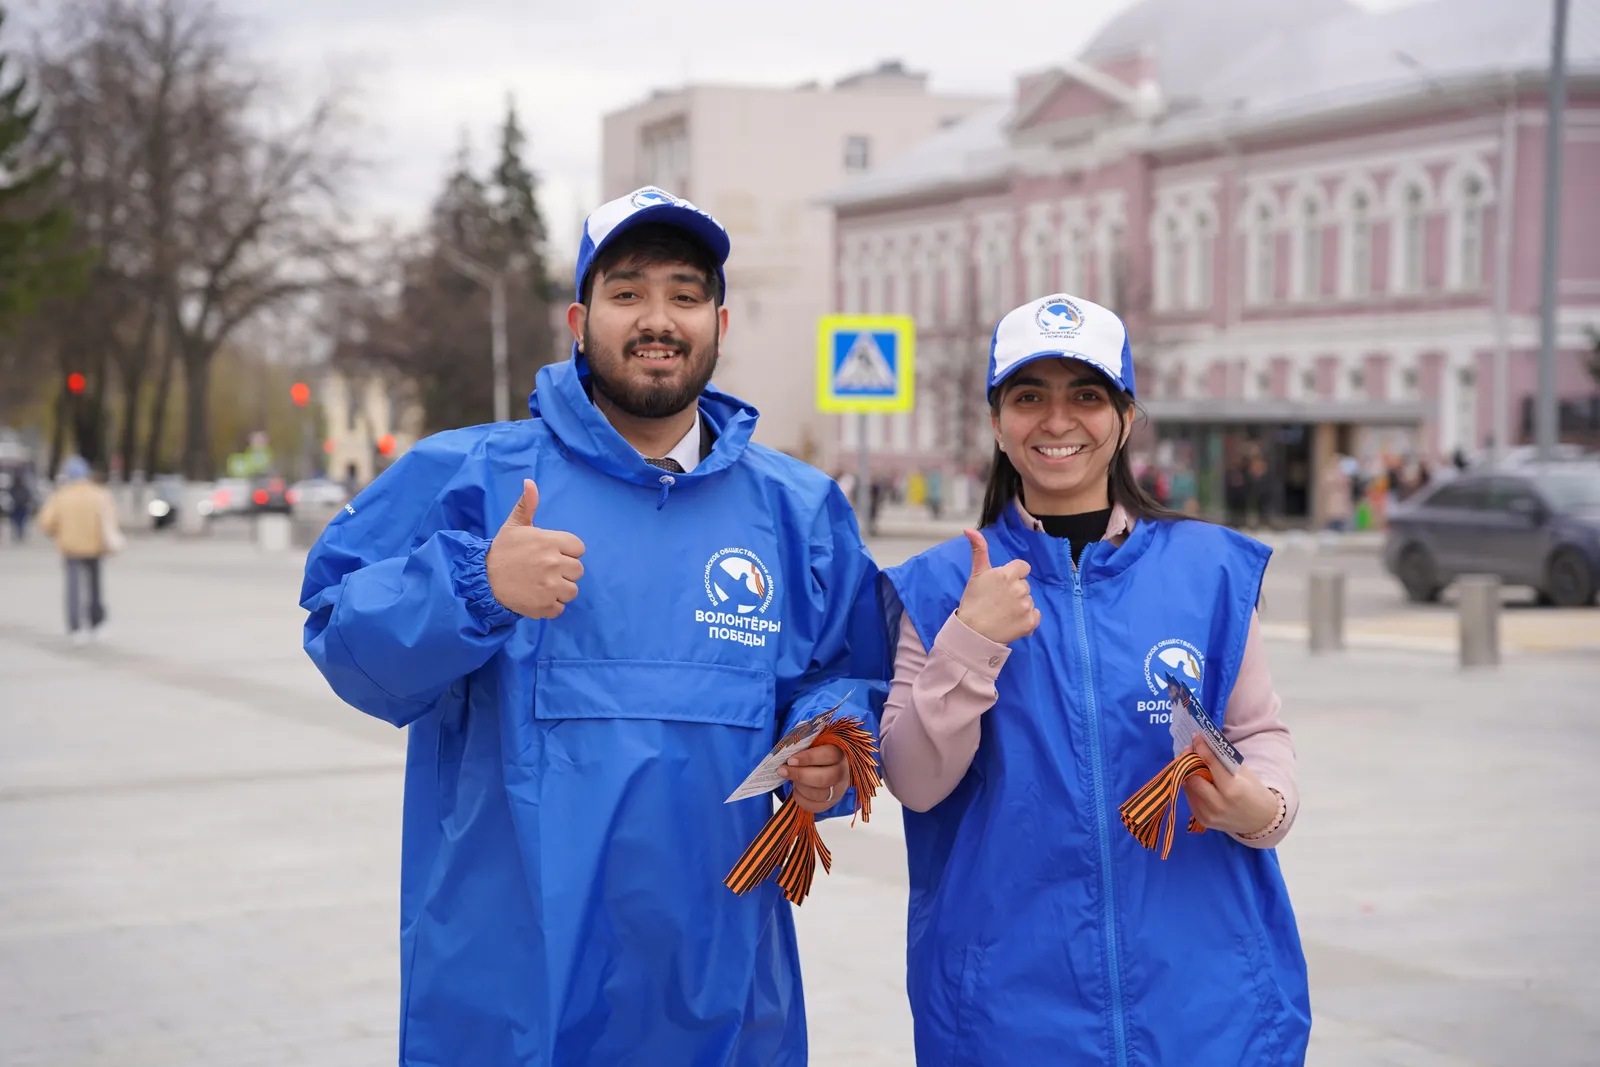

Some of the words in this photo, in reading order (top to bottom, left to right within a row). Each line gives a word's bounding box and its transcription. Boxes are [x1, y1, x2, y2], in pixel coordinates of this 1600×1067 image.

[704, 552, 720, 607] ВСЕРОССИЙСКОЕ
[720, 547, 769, 574] ОБЩЕСТВЕННОЕ
[759, 574, 774, 613] ДВИЖЕНИЕ
[695, 609, 781, 633] ВОЛОНТЁРЫ
[709, 626, 766, 647] ПОБЕДЫ
[1143, 645, 1159, 696] ВСЕРОССИЙСКОЕ
[1158, 638, 1205, 661] ОБЩЕСТВЕННОЕ
[1137, 700, 1173, 712] ВОЛО
[1189, 695, 1236, 757] ИСТОРИЯ
